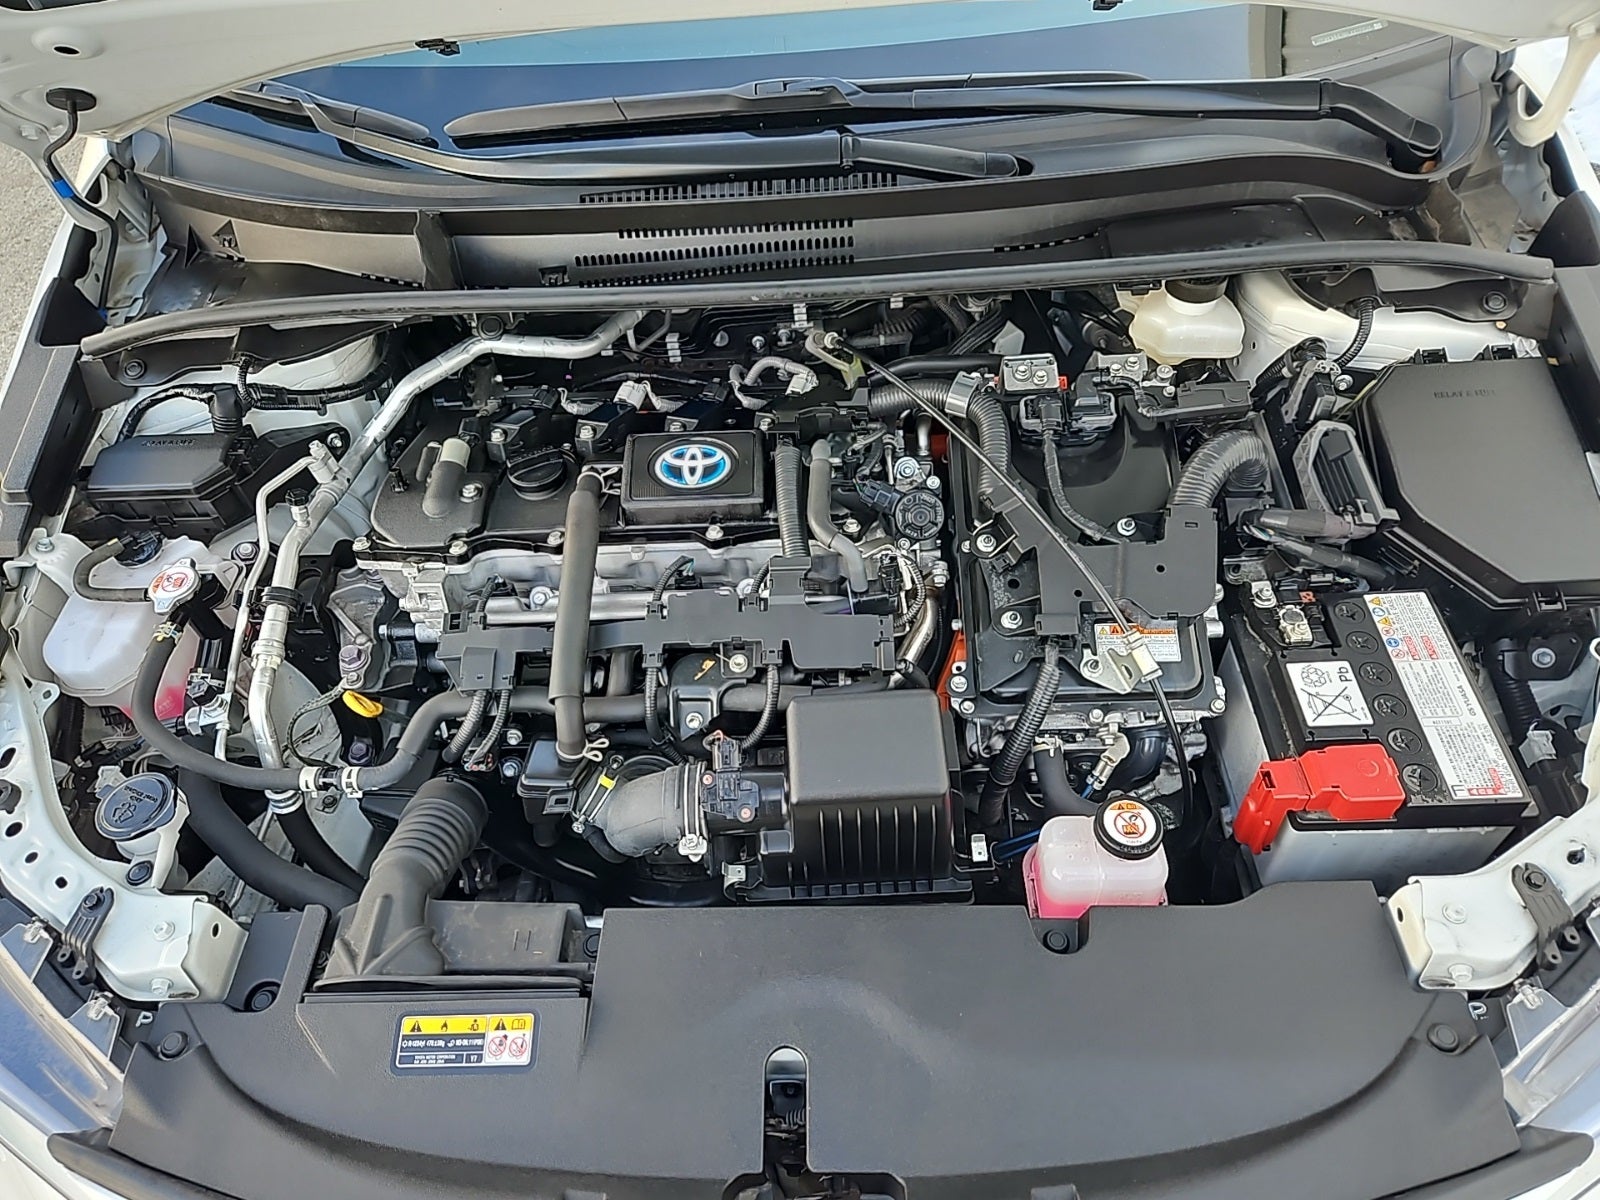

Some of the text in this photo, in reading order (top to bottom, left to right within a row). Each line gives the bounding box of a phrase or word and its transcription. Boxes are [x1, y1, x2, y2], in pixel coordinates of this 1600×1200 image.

[1336, 666, 1353, 683] Pb
[1455, 684, 1472, 706] YUASA
[1466, 706, 1477, 716] GS
[135, 1010, 154, 1028] P
